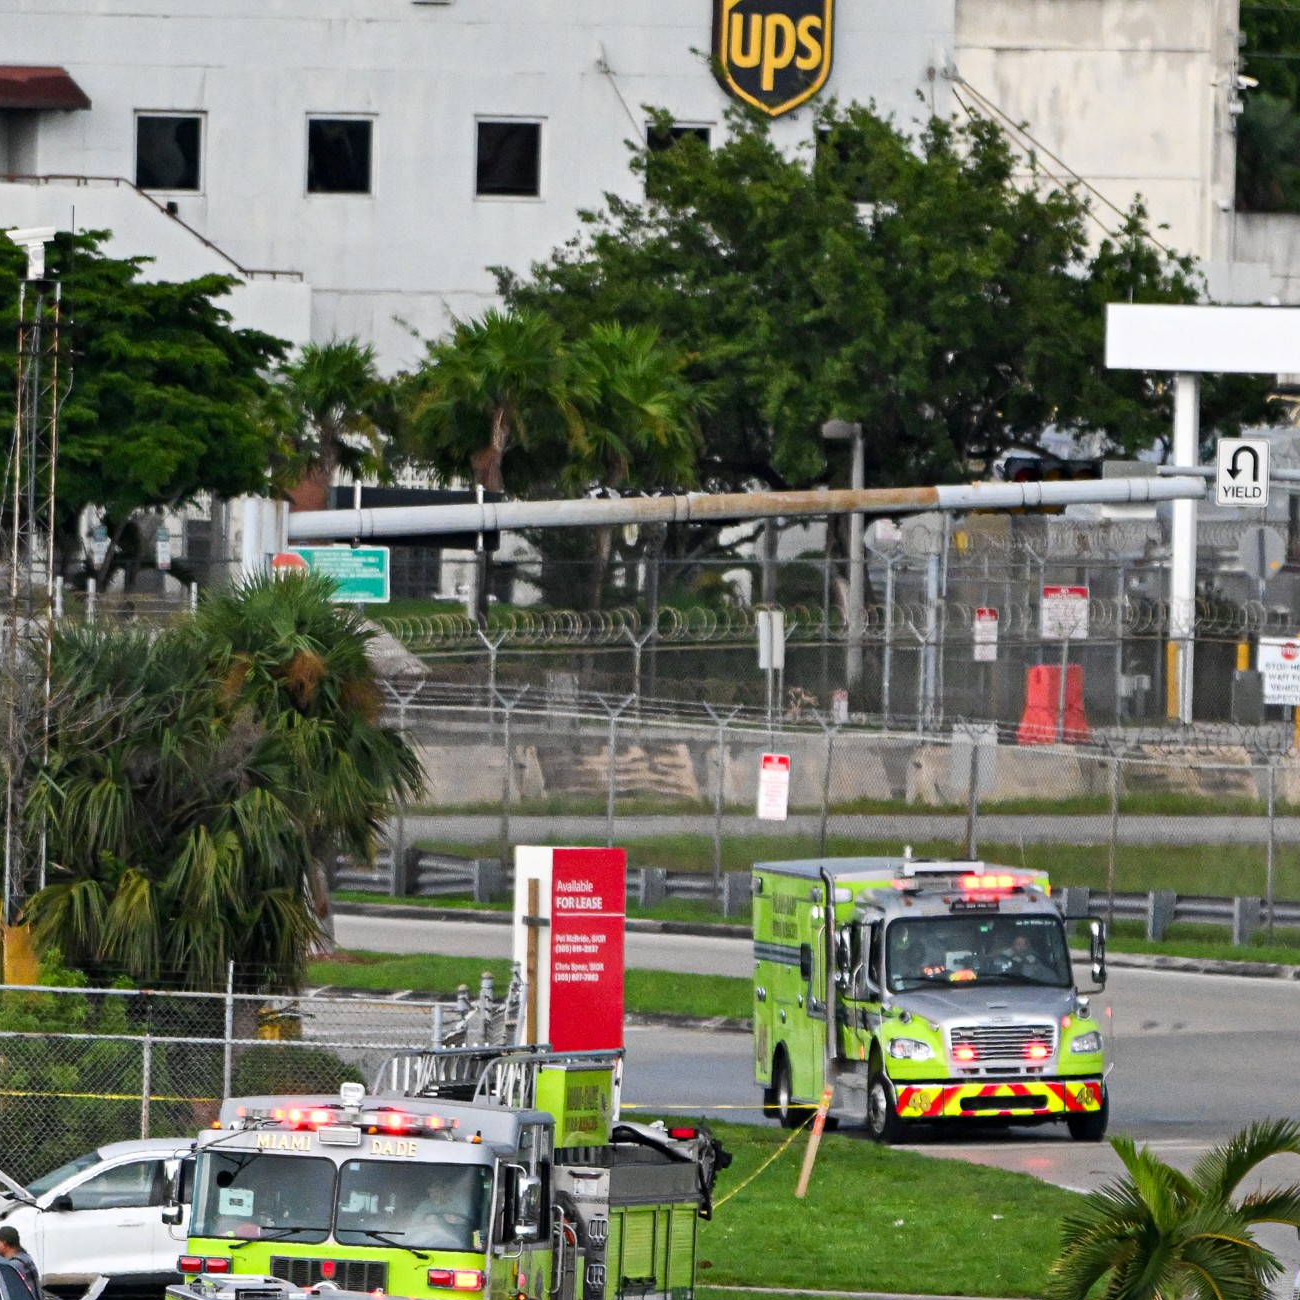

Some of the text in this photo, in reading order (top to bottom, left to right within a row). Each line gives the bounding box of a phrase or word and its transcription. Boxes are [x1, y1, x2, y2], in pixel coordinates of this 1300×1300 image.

[731, 13, 822, 91] ups
[1222, 486, 1262, 498] YIELD
[557, 881, 593, 893] Available
[556, 897, 603, 910] FOR LEASE
[908, 1091, 932, 1112] 48
[1075, 1086, 1095, 1106] 48
[256, 1134, 417, 1157] MIAMI DADE
